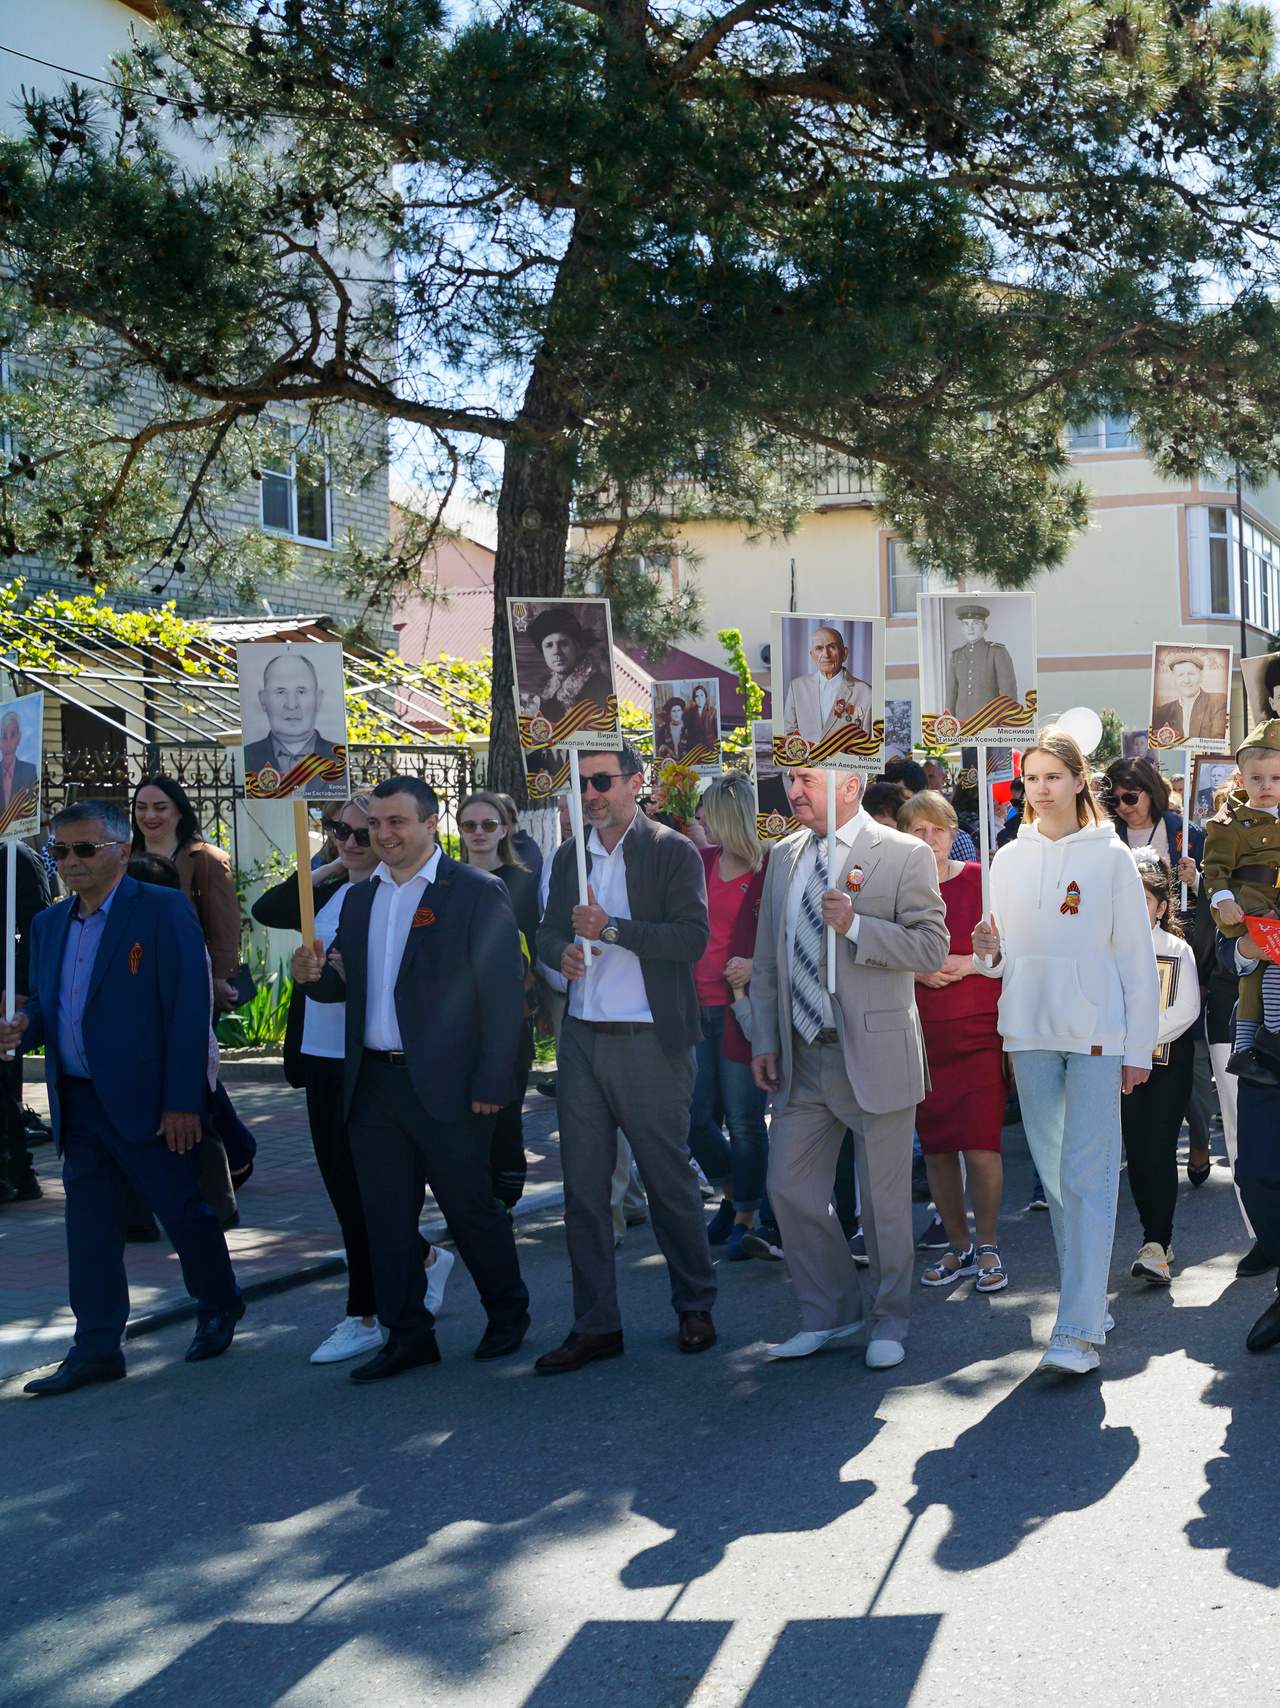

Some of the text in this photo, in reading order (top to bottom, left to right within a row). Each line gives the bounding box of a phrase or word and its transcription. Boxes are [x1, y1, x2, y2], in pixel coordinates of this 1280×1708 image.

[597, 732, 619, 740] Вирко
[939, 736, 1035, 744] Тимофей Ксенофонтович
[585, 740, 620, 748] Иванович
[858, 754, 882, 763] Кялов
[837, 762, 882, 770] Аверьянович
